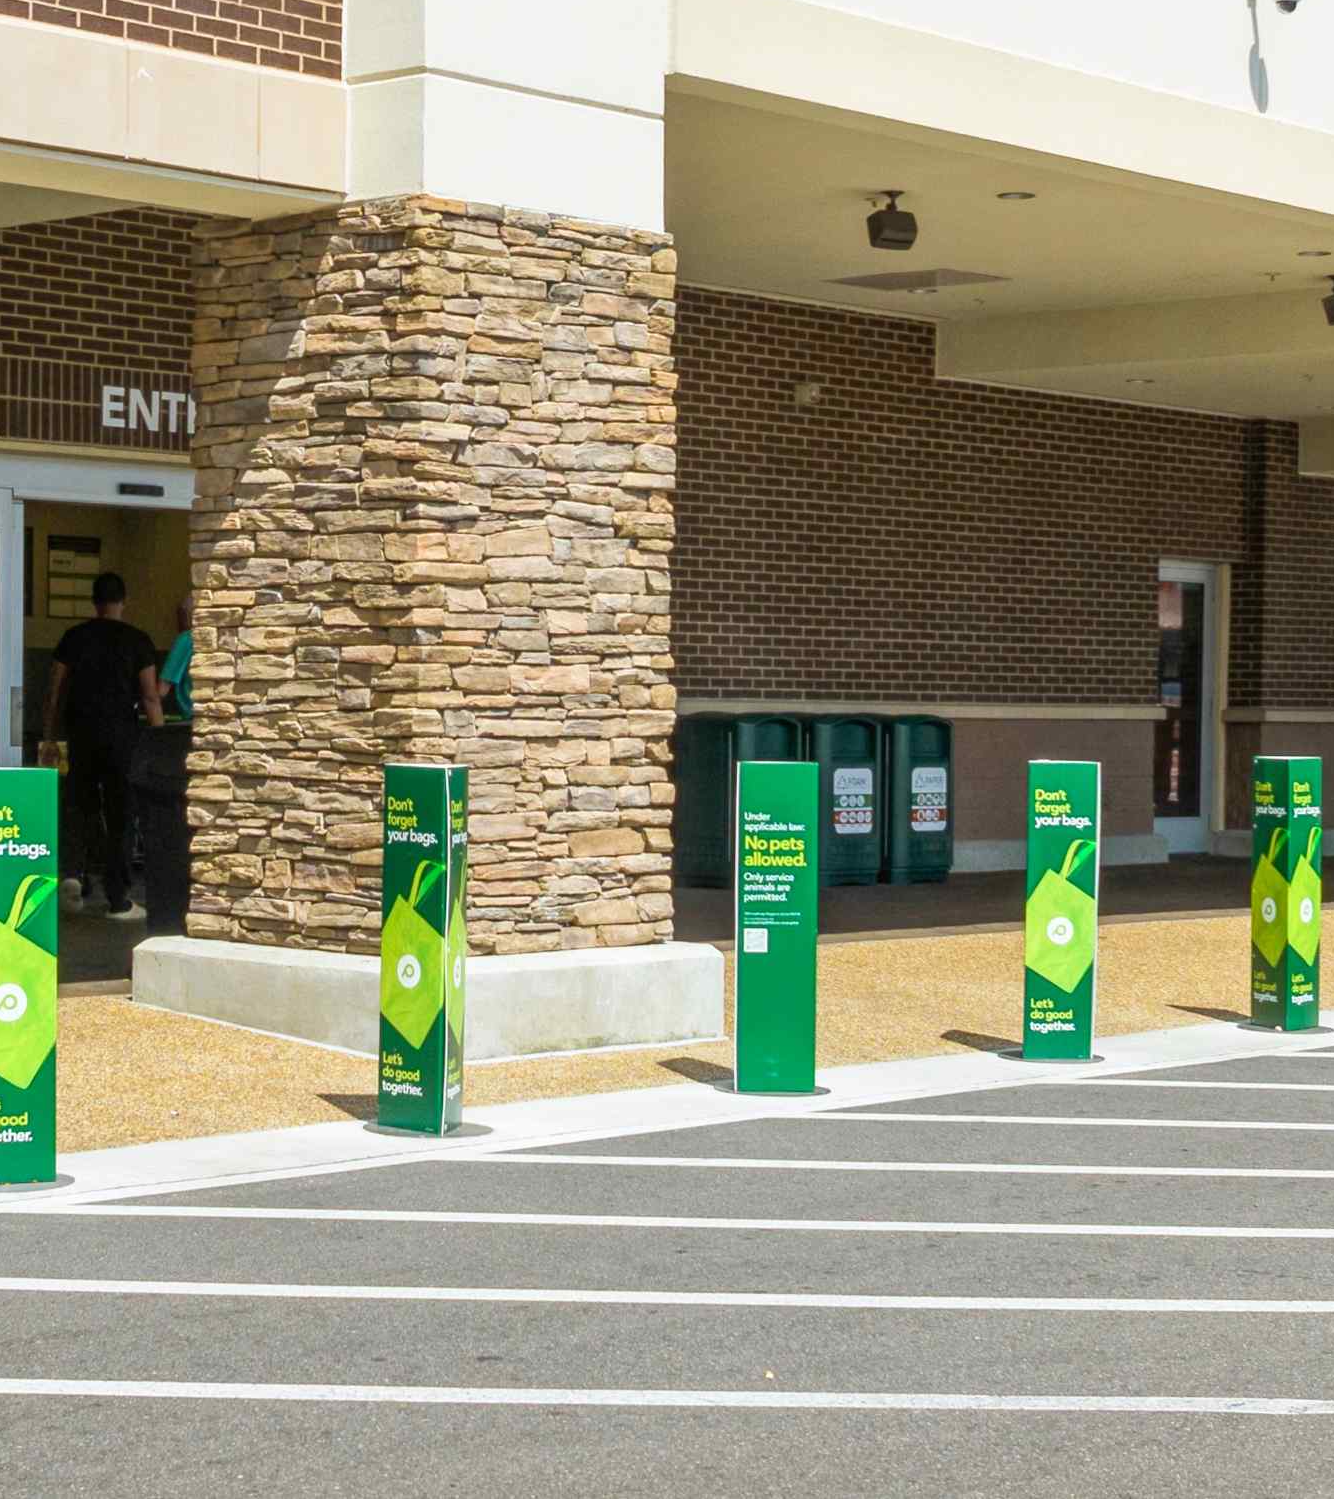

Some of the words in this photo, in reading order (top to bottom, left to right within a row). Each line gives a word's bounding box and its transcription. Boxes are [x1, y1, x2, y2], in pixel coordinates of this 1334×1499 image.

[1035, 788, 1067, 801] Don't
[388, 796, 413, 812] Don't
[1035, 801, 1071, 816] forget
[387, 812, 418, 830] forget
[744, 812, 771, 821] Under
[1035, 816, 1061, 829] your
[744, 822, 787, 832] applicable
[387, 829, 409, 844] your
[410, 828, 438, 847] bags.
[745, 835, 767, 850] No
[769, 837, 804, 853] pets
[8, 839, 50, 860] bags.
[744, 852, 807, 867] allowed.
[743, 872, 764, 883] Only
[766, 872, 794, 882] service
[743, 883, 775, 891] animals
[743, 892, 788, 903] permitted.
[1030, 998, 1054, 1009] Let's
[1030, 1009, 1044, 1019] do
[1045, 1009, 1073, 1021] good
[383, 1051, 403, 1066] Let's
[382, 1065, 394, 1078] do
[395, 1070, 420, 1082] good
[382, 1080, 423, 1096] together.
